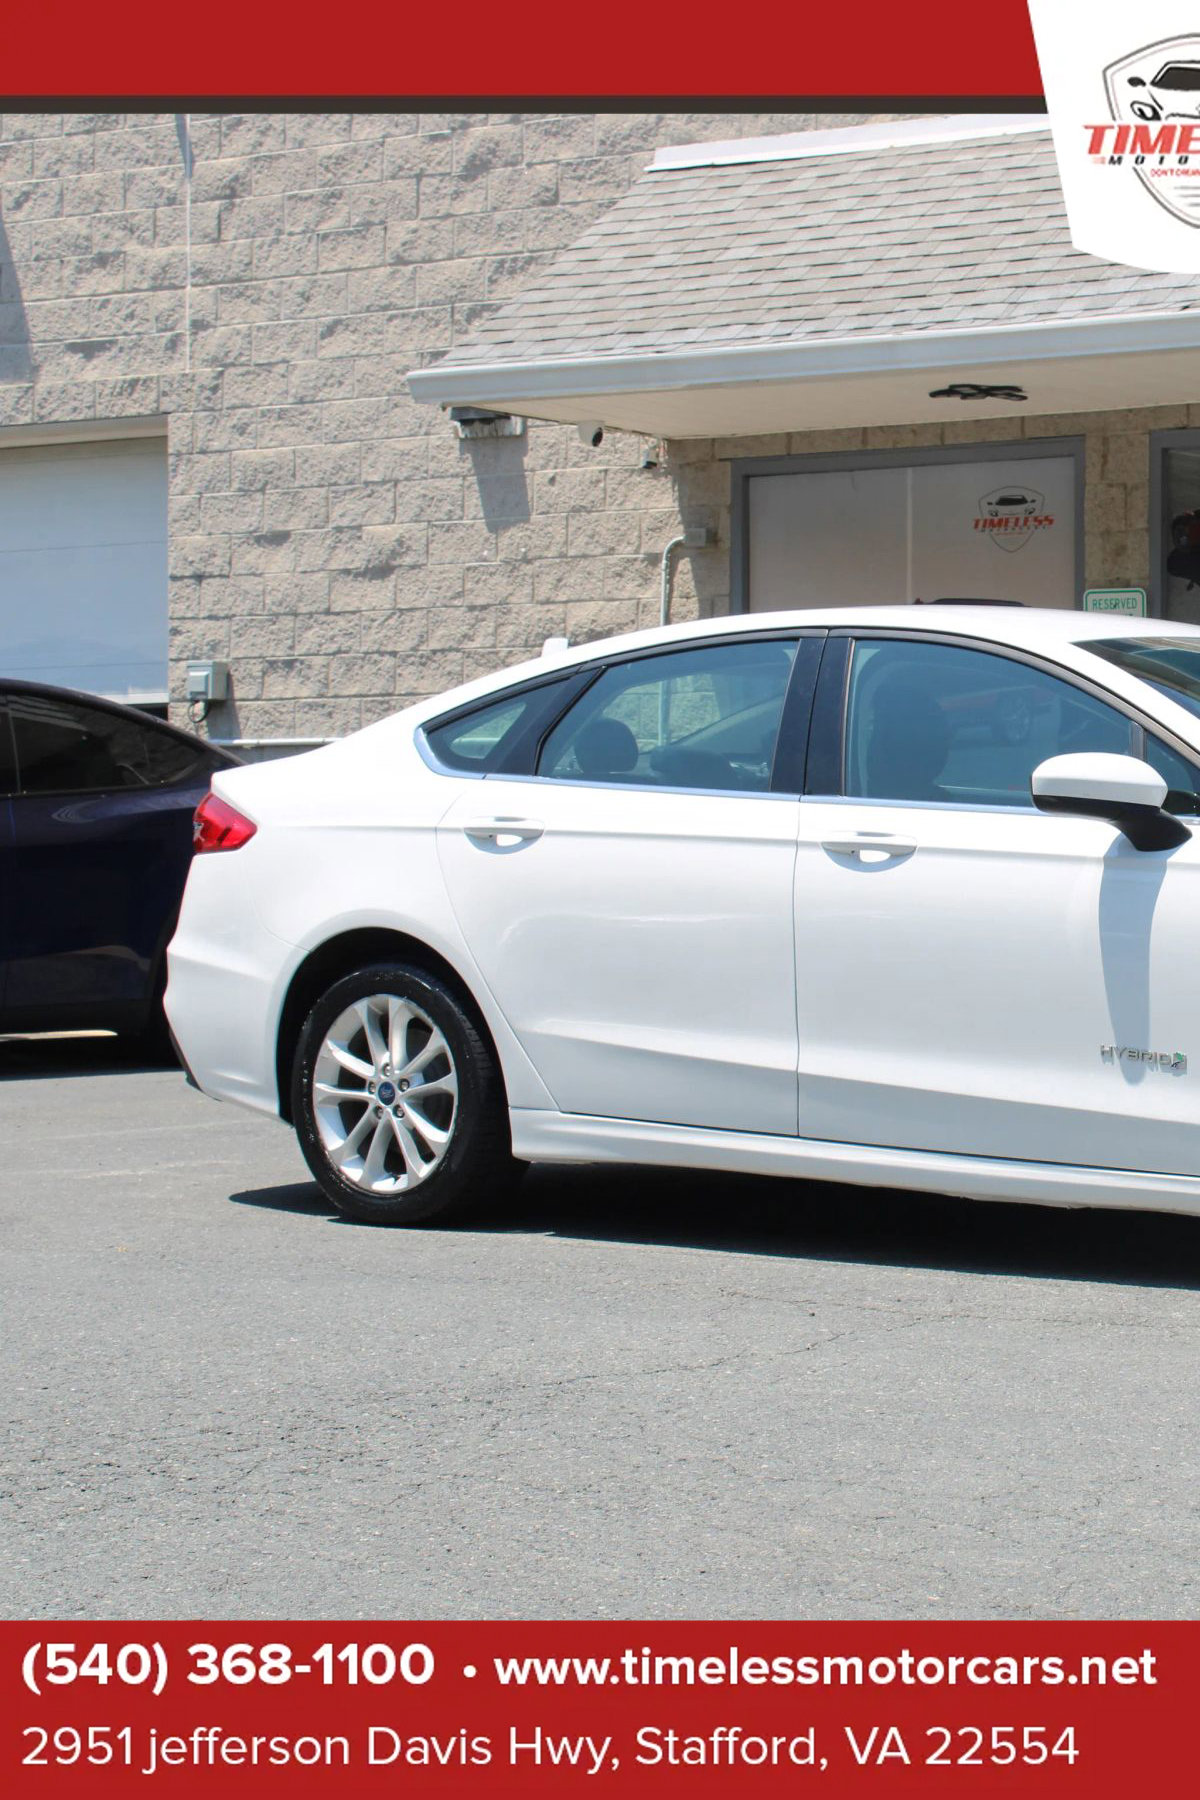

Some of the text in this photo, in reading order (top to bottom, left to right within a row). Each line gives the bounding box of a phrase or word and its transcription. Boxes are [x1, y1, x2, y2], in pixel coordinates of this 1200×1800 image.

[973, 515, 1057, 530] TIMELESS
[1092, 597, 1138, 610] RESERVED
[1101, 1044, 1172, 1066] HYBRID
